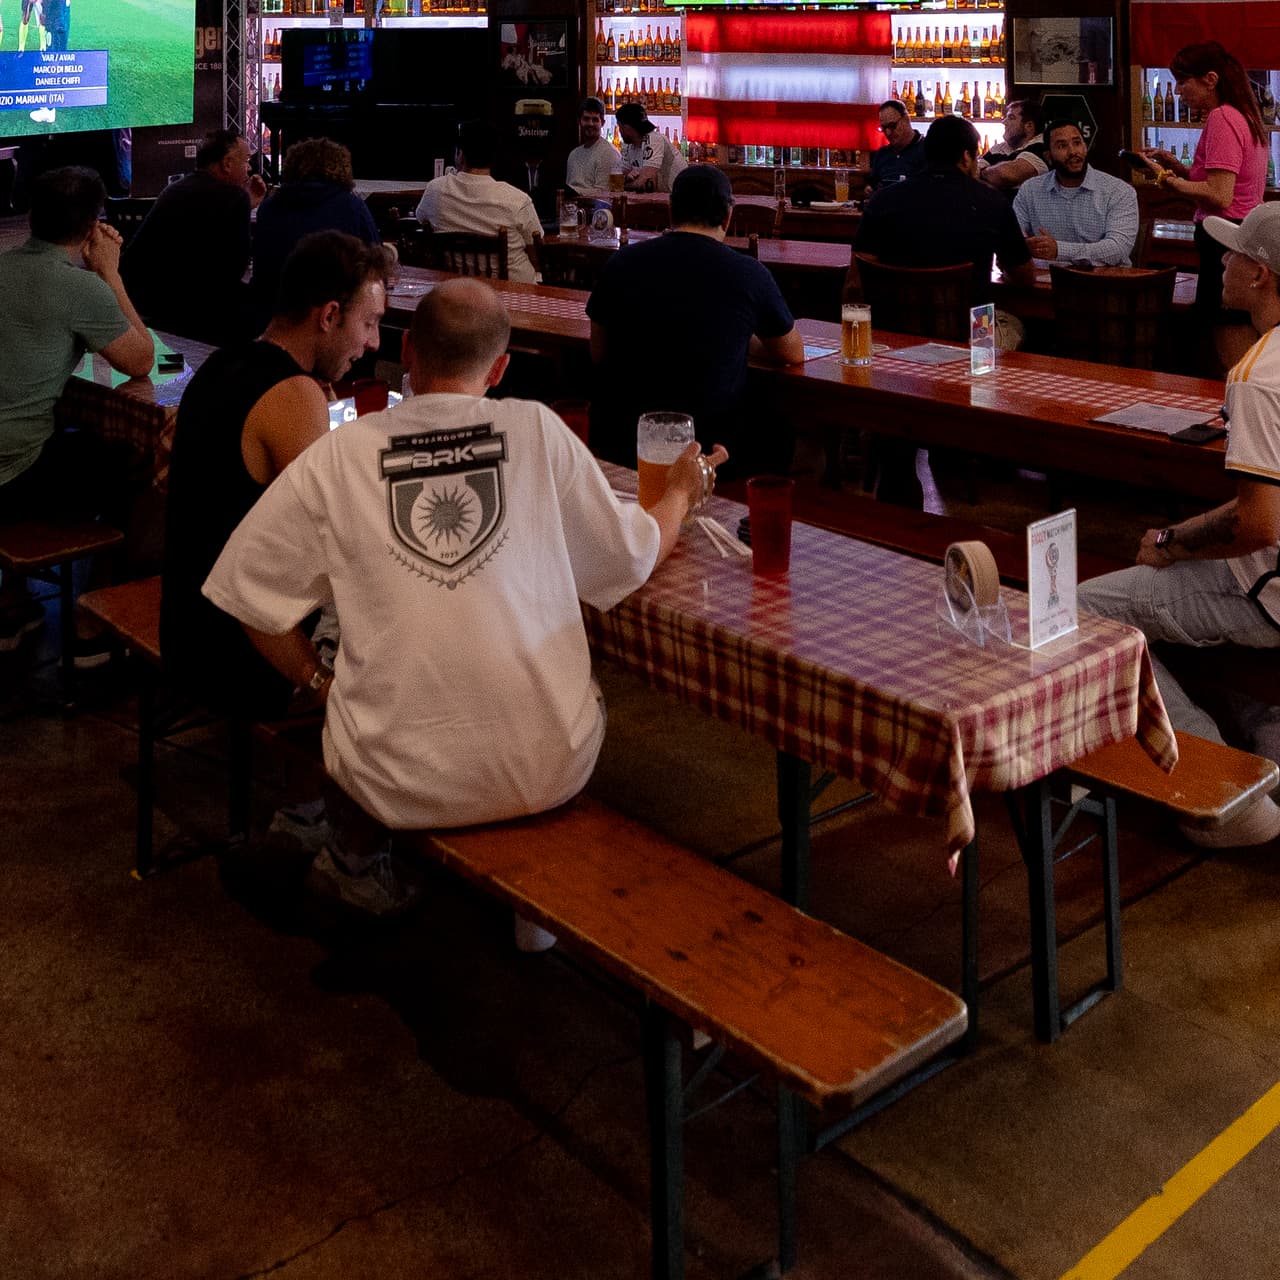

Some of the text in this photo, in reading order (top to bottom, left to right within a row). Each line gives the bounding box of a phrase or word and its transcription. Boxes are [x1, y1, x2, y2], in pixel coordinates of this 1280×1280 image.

[33, 66, 57, 74] MARCO
[64, 65, 84, 73] BELLO
[35, 77, 61, 86] DANIELE
[15, 94, 47, 104] MARIANI
[48, 93, 65, 104] (ITA)
[412, 444, 474, 469] BRK
